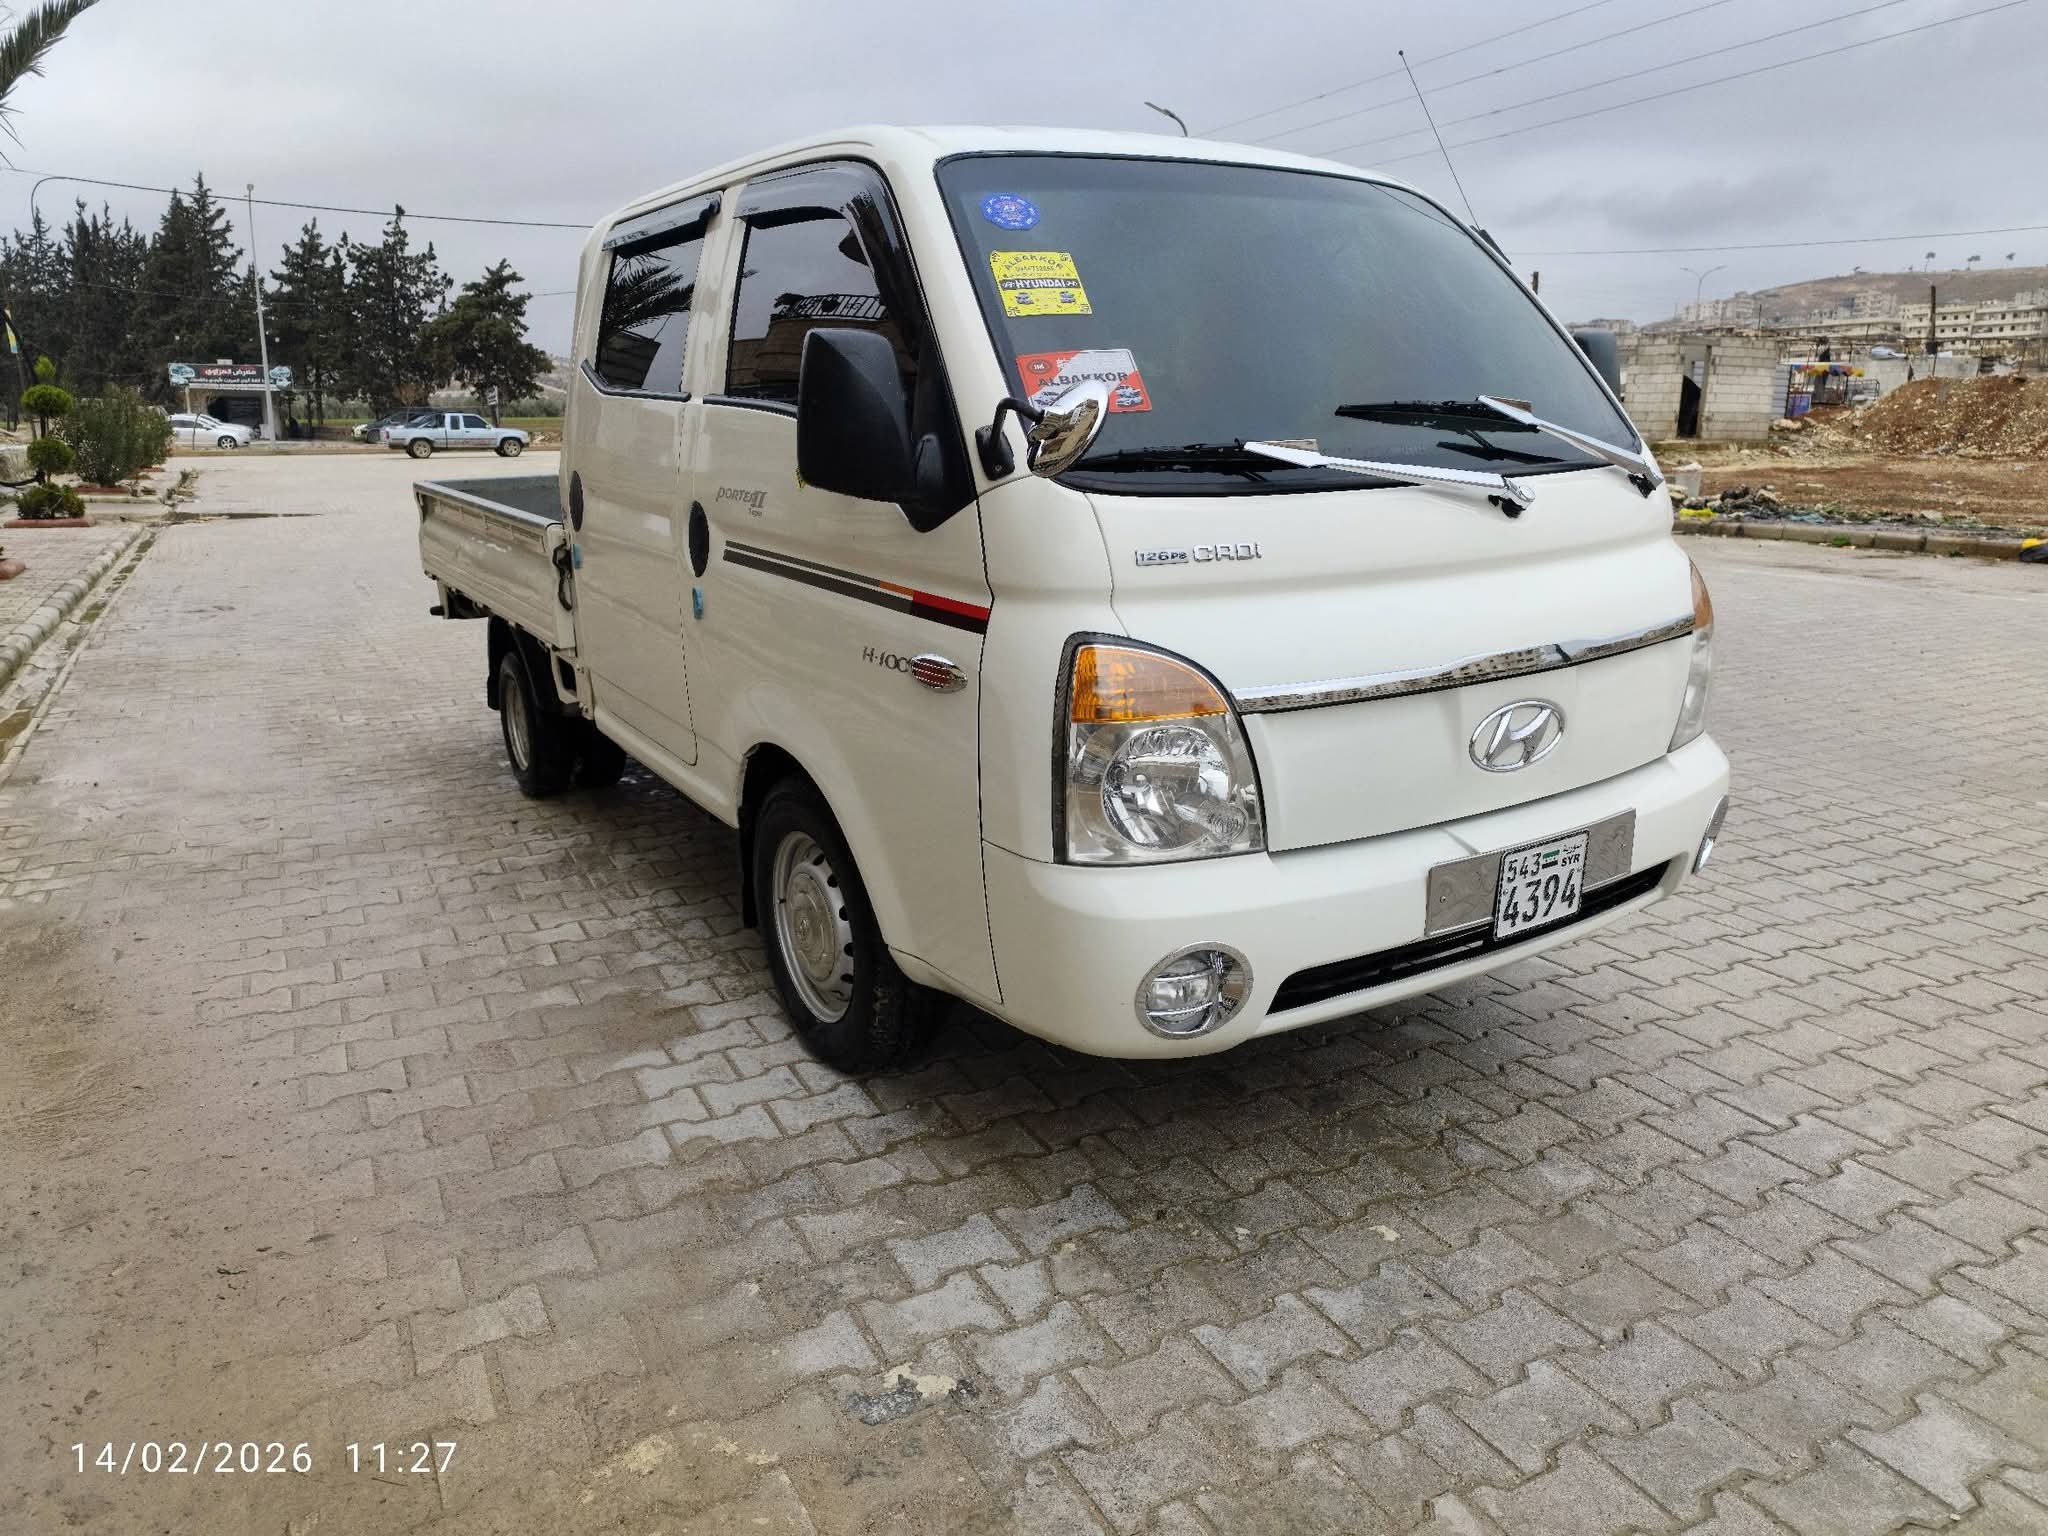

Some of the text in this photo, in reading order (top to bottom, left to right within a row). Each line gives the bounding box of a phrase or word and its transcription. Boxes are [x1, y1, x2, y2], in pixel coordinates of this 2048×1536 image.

[1015, 278, 1066, 289] HYUNDAI
[1506, 852, 1542, 883] 543
[1560, 853, 1581, 868] SYR
[1502, 868, 1577, 927] 4394
